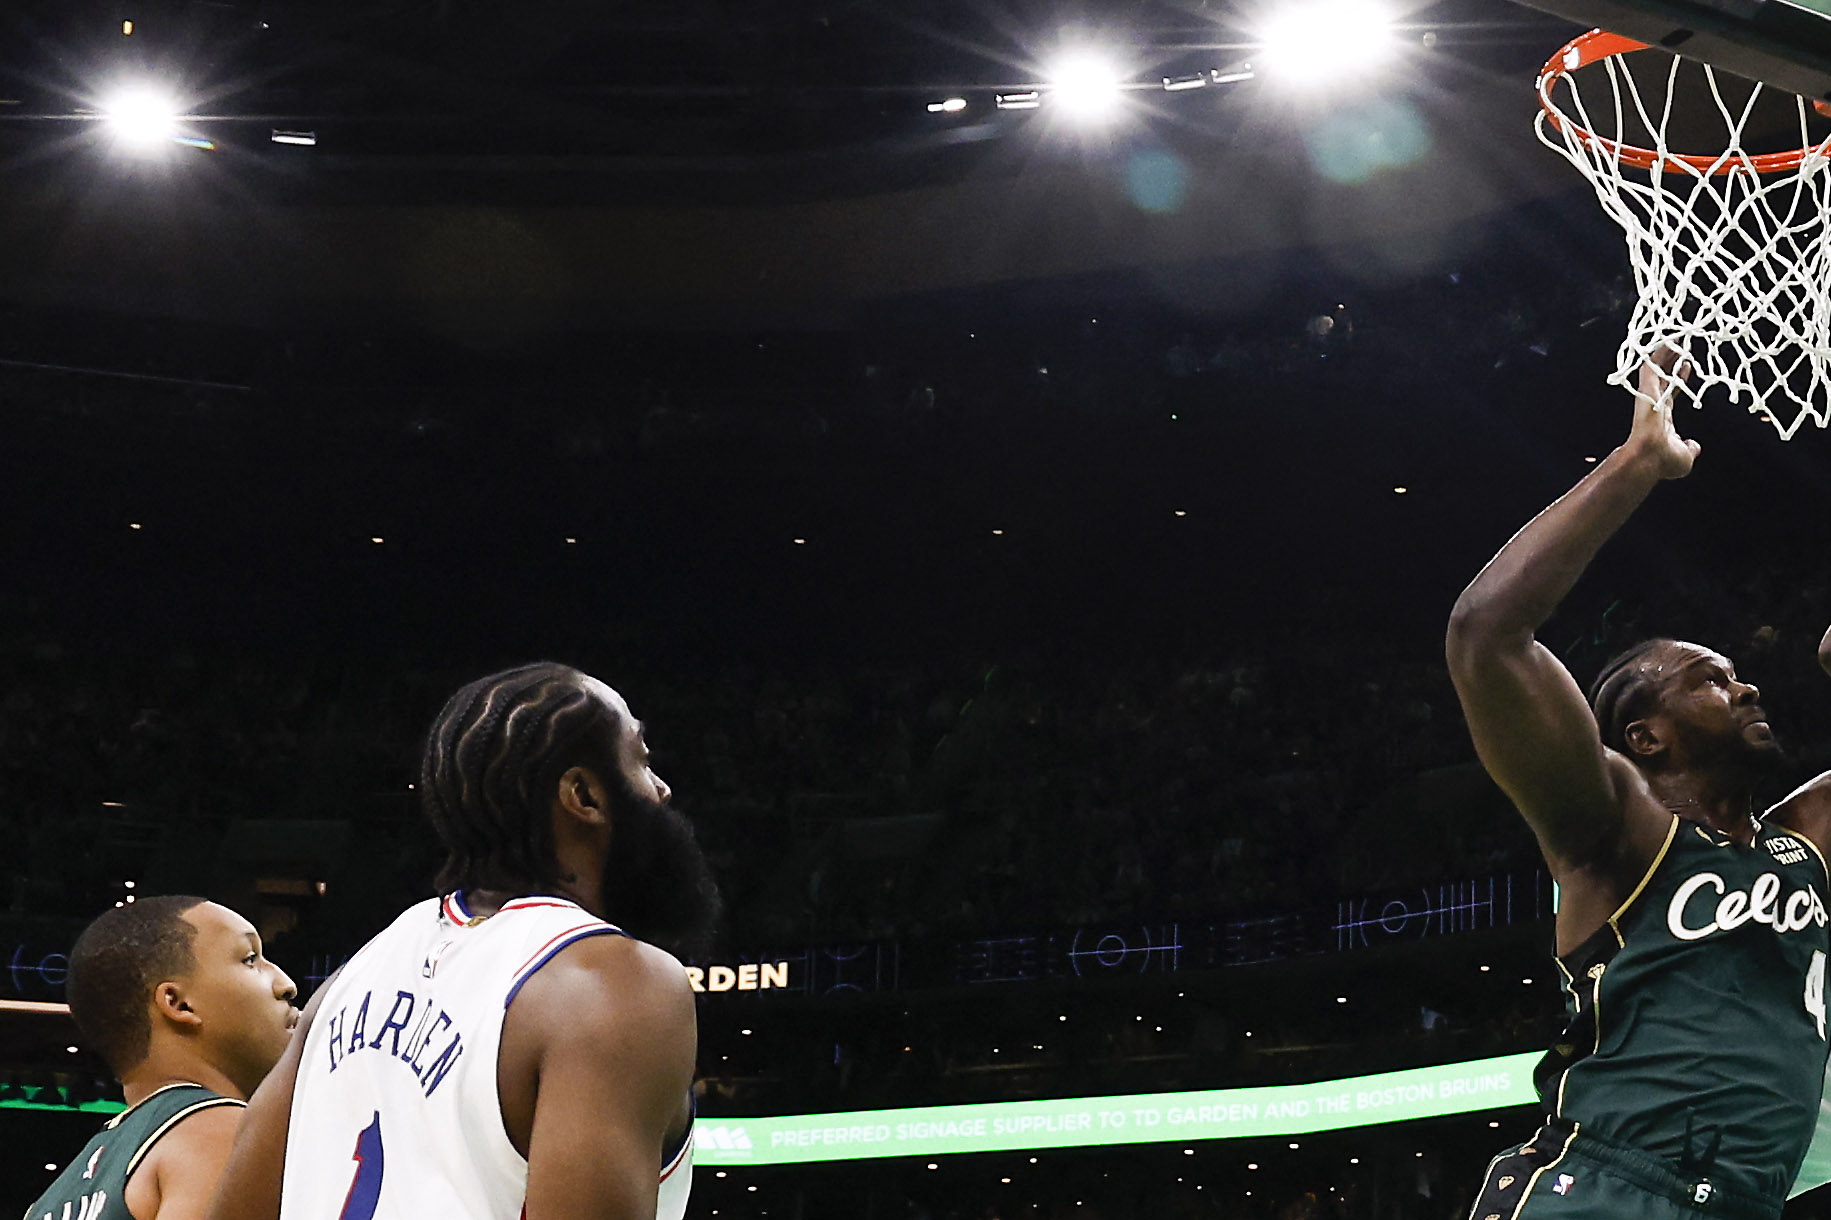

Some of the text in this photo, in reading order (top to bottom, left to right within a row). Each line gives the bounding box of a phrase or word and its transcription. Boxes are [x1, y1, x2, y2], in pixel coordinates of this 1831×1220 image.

[1803, 949, 1827, 1042] 4
[329, 989, 464, 1100] HARDEN
[770, 1123, 891, 1149] PREFERRED
[895, 1118, 988, 1141] SIGNAGE
[992, 1111, 1092, 1135] SUPPLIER
[1096, 1110, 1127, 1129] TO
[1132, 1108, 1161, 1127] TD
[1166, 1101, 1259, 1125] GARDEN
[1263, 1100, 1310, 1119] AND
[1315, 1094, 1351, 1114] THE
[1355, 1082, 1435, 1110] BOSTON
[1438, 1071, 1512, 1098] BRUINS
[1693, 1183, 1712, 1204] 6
